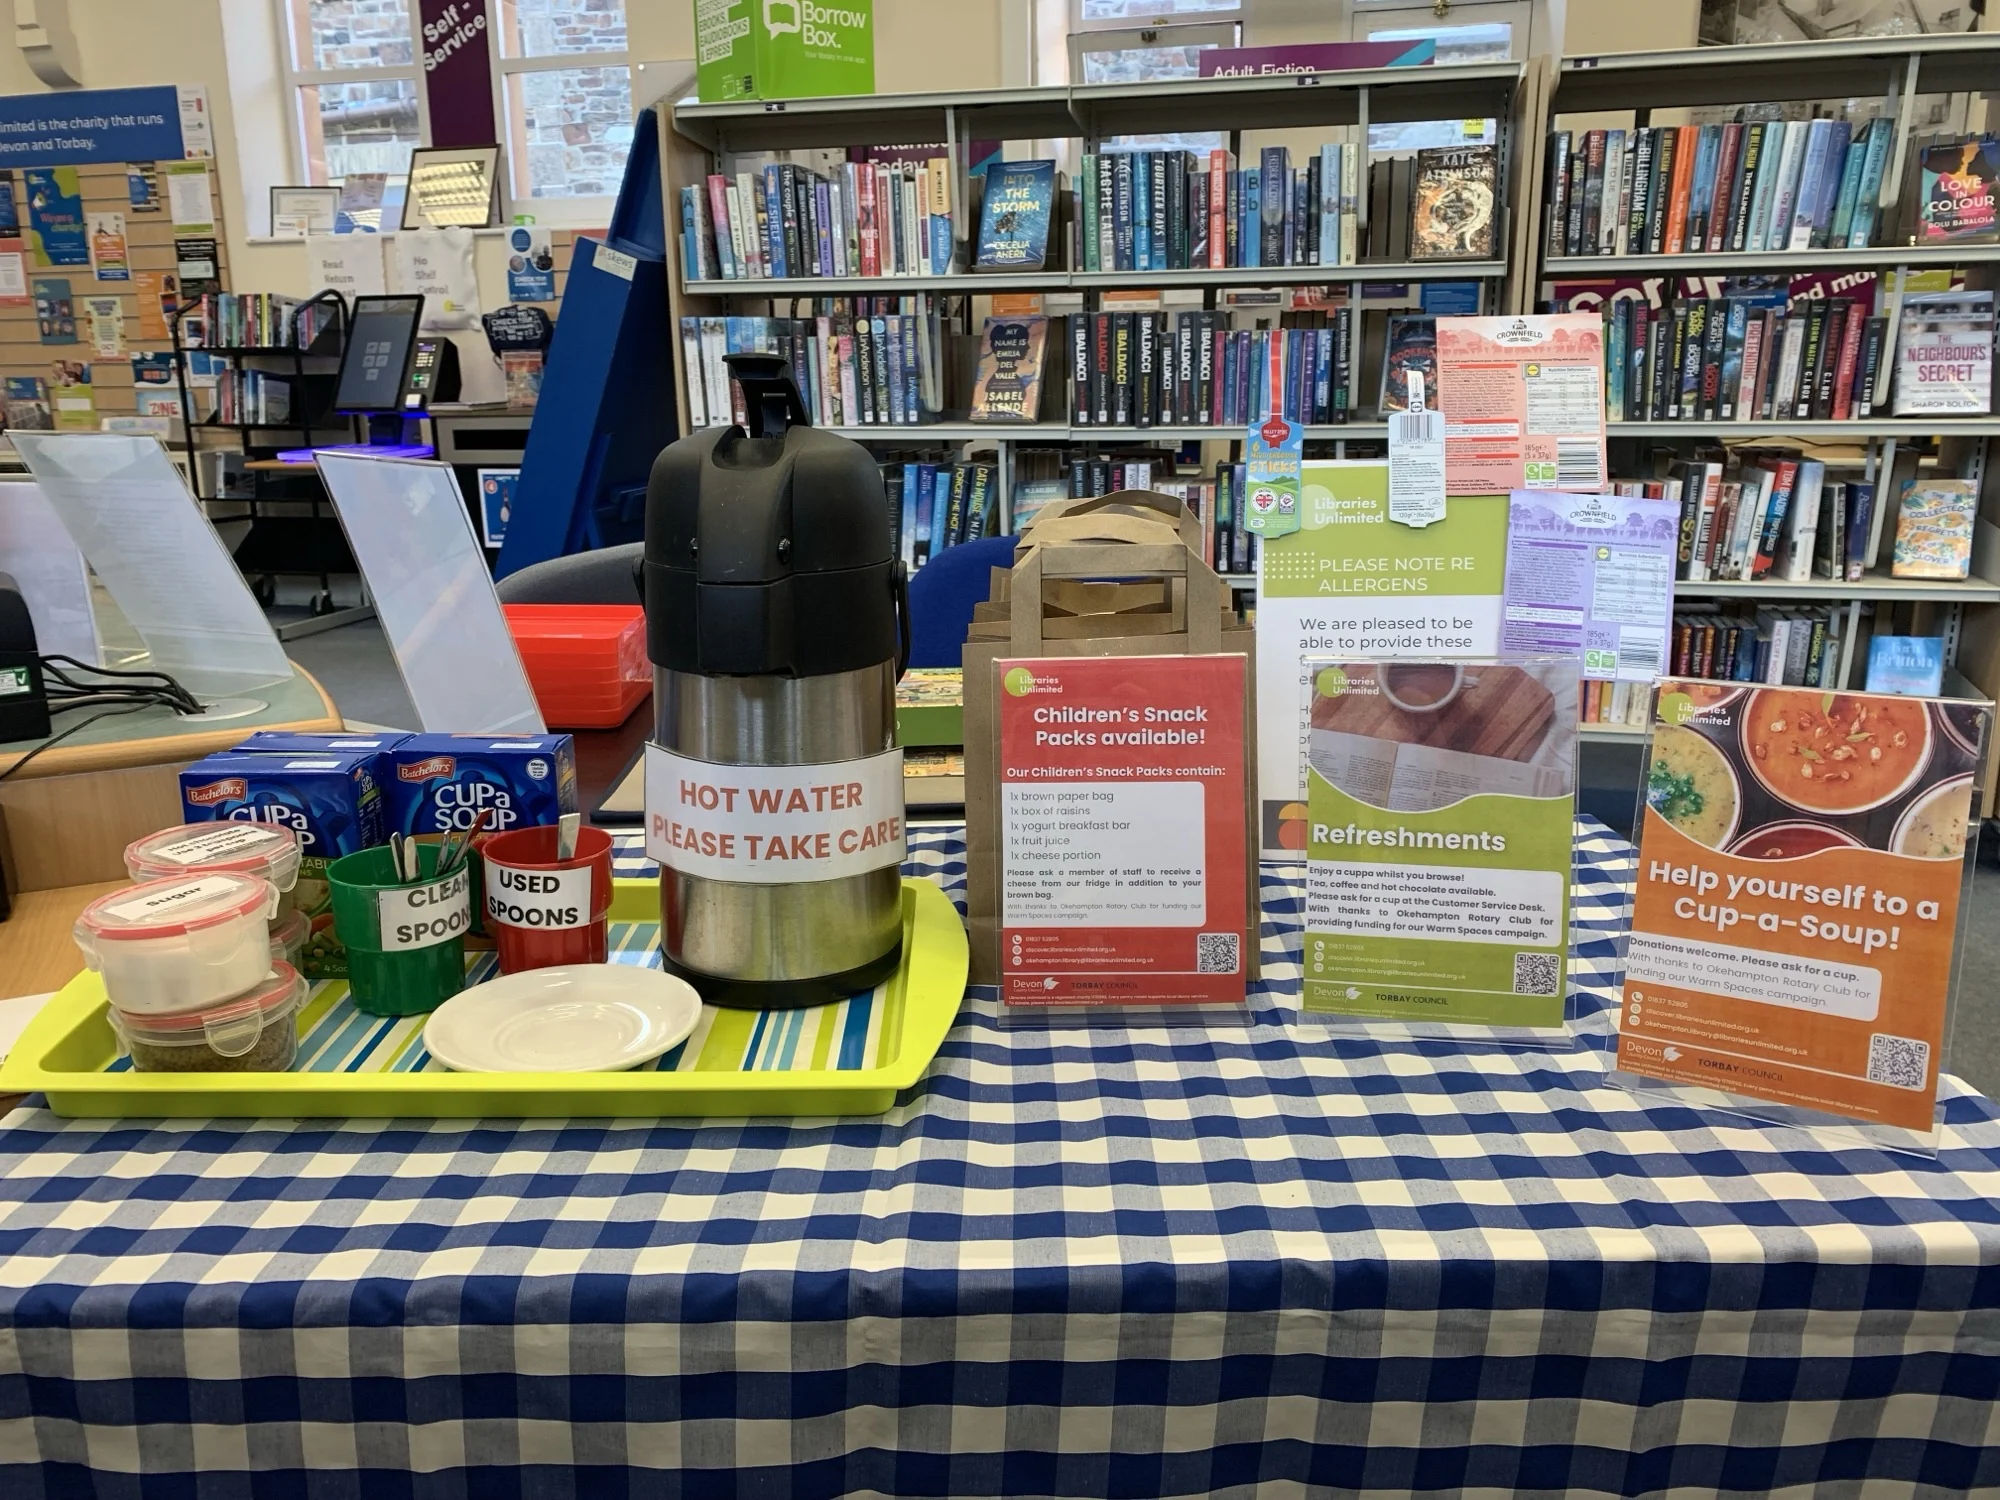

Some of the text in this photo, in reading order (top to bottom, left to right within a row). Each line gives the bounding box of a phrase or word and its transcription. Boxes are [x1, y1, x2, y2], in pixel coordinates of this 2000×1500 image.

[803, 1, 866, 28] Borrow
[424, 4, 460, 42] Self
[424, 15, 486, 71] Service
[803, 23, 841, 48] Box.
[1214, 64, 1254, 77] Adult
[38, 114, 163, 130] is the charity that runs
[32, 137, 96, 151] and Torbay.
[1443, 154, 1474, 166] KATE
[1632, 148, 1651, 211] BILLINGHAM
[1941, 177, 1982, 192] LOVE
[783, 170, 795, 218] the couple
[1005, 188, 1030, 199] THE
[1155, 160, 1164, 236] FOURTEEN DAYS
[1956, 190, 1967, 199] IN
[992, 201, 1040, 213] STORM
[1100, 160, 1114, 246] MAGPIE LANE
[1120, 182, 1128, 221] ATKINSON
[1929, 195, 1994, 212] COLOUR
[1654, 211, 1662, 238] BLOOD
[1952, 216, 1994, 226] BABALOLA
[414, 257, 428, 265] No
[996, 250, 1026, 258] AHERN
[1496, 329, 1543, 340] CROWNFIELD
[1938, 334, 1953, 344] THE
[1744, 324, 1760, 380] PRETENDING
[1908, 344, 1986, 361] NEIGHBOUR'S
[1919, 364, 1975, 382] SECRET
[984, 392, 1023, 401] ISABEL
[1802, 385, 1812, 399] BOX
[150, 402, 178, 415] ZINE
[977, 403, 1028, 412] ALLENDE
[1774, 470, 1795, 517] TOM BRADBY
[1315, 497, 1377, 509] Libraries
[1315, 511, 1384, 524] Unlimited
[1570, 510, 1617, 522] CROWNFIELD
[1909, 506, 1965, 518] COLLECTED
[1916, 526, 1958, 536] REGRETS
[1320, 557, 1474, 572] PLEASE NOTE RE
[1318, 578, 1428, 592] ALLERGENS
[1299, 617, 1473, 632] We are pleased to be
[1299, 635, 1472, 650] able to provide these
[1020, 675, 1059, 684] Libraries
[1333, 677, 1375, 686] Libraries
[1020, 684, 1063, 693] Unlimited
[1333, 686, 1379, 695] Unlimited
[1034, 706, 1208, 723] Children's Snack
[1679, 703, 1726, 715] Libraries
[1677, 713, 1731, 726] Unlimited
[1036, 728, 1205, 745] Packs available!
[401, 762, 451, 780] Batchelors
[1007, 765, 1225, 777] Our Children's Snack Packs contain:
[191, 783, 242, 802] Batchelors
[435, 783, 510, 809] CUPa
[680, 779, 863, 814] HOT WATER
[1010, 792, 1114, 803] 1x brown paper bag
[435, 807, 517, 831] SOUP
[653, 814, 900, 861] PLEASE TAKE CARE
[1313, 824, 1505, 850] Refreshments
[1309, 867, 1334, 877] Enjoy
[1343, 870, 1374, 878] cuppa
[1375, 870, 1404, 878] whilst
[1426, 873, 1464, 881] browse!
[499, 869, 561, 895] USED
[1649, 861, 1939, 920] Help yourself to a
[489, 896, 578, 926] SPOONS
[1674, 898, 1900, 950] Cup-a-Soup!
[1630, 937, 1684, 953] Donations
[1686, 948, 1739, 961] welcome.
[1741, 955, 1779, 968] Please
[1781, 963, 1802, 972] ask
[1804, 964, 1821, 975] for
[1833, 971, 1859, 982] cup.
[1626, 1041, 1662, 1058] Devon
[1698, 1059, 1782, 1081] TORBAY COUNCIL
